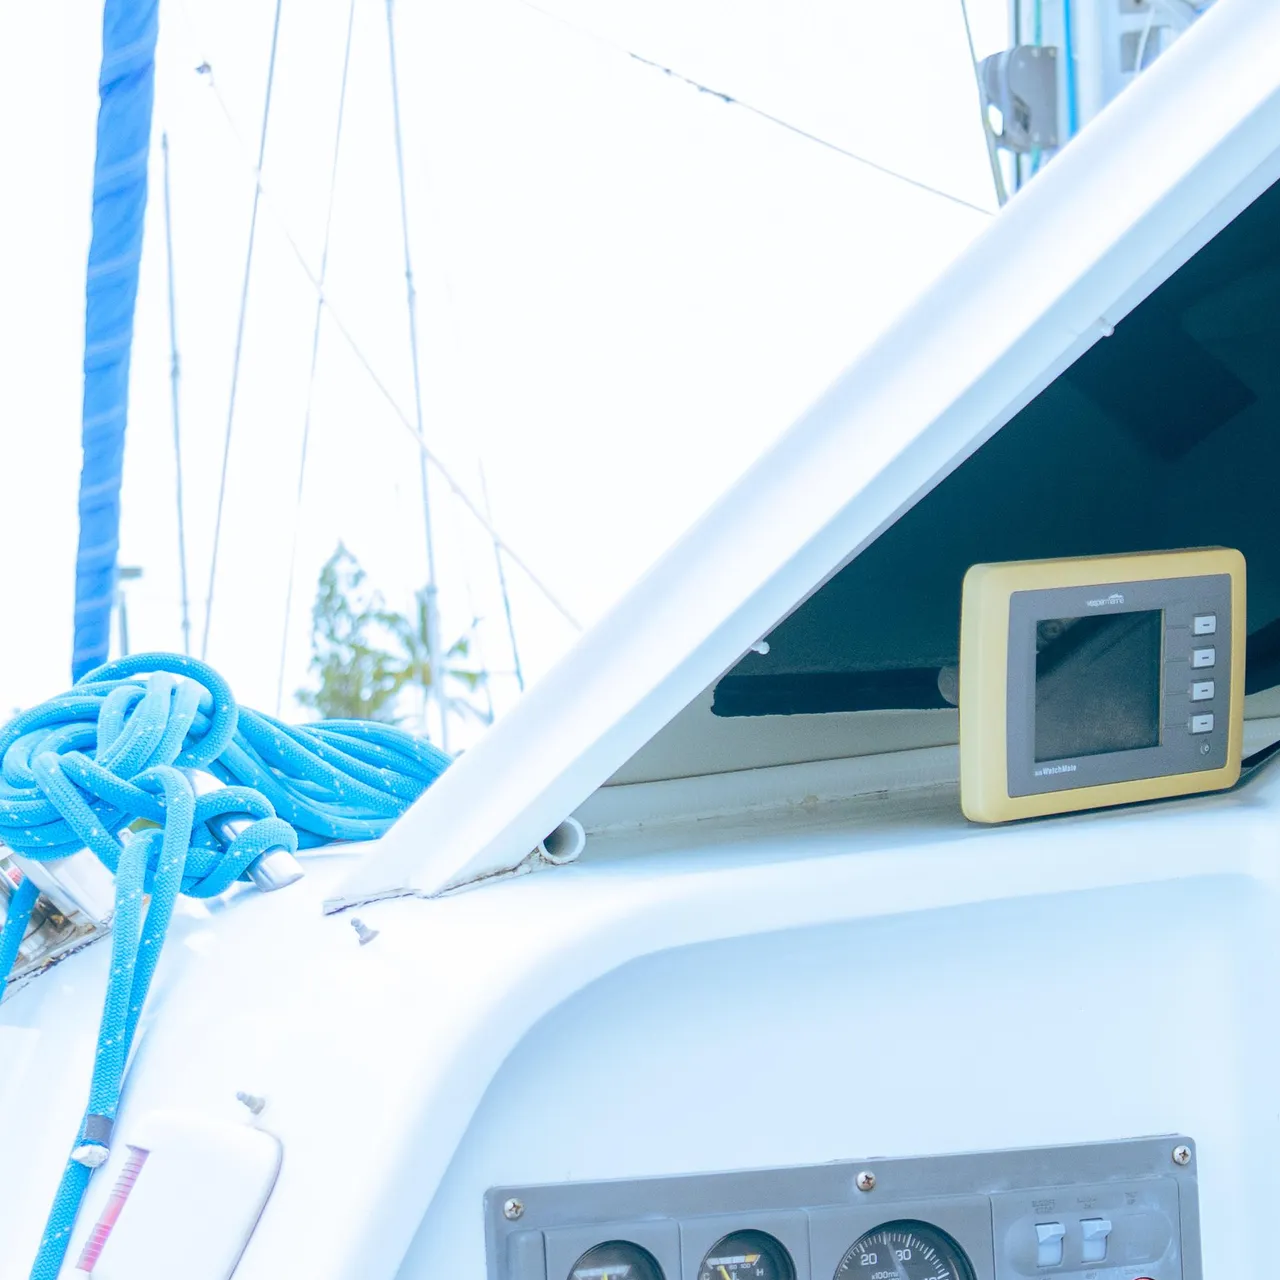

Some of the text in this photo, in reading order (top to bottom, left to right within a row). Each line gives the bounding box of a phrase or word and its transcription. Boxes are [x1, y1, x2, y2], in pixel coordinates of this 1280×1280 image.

[860, 1252, 878, 1266] 20
[895, 1249, 912, 1261] 30
[756, 1268, 764, 1277] H
